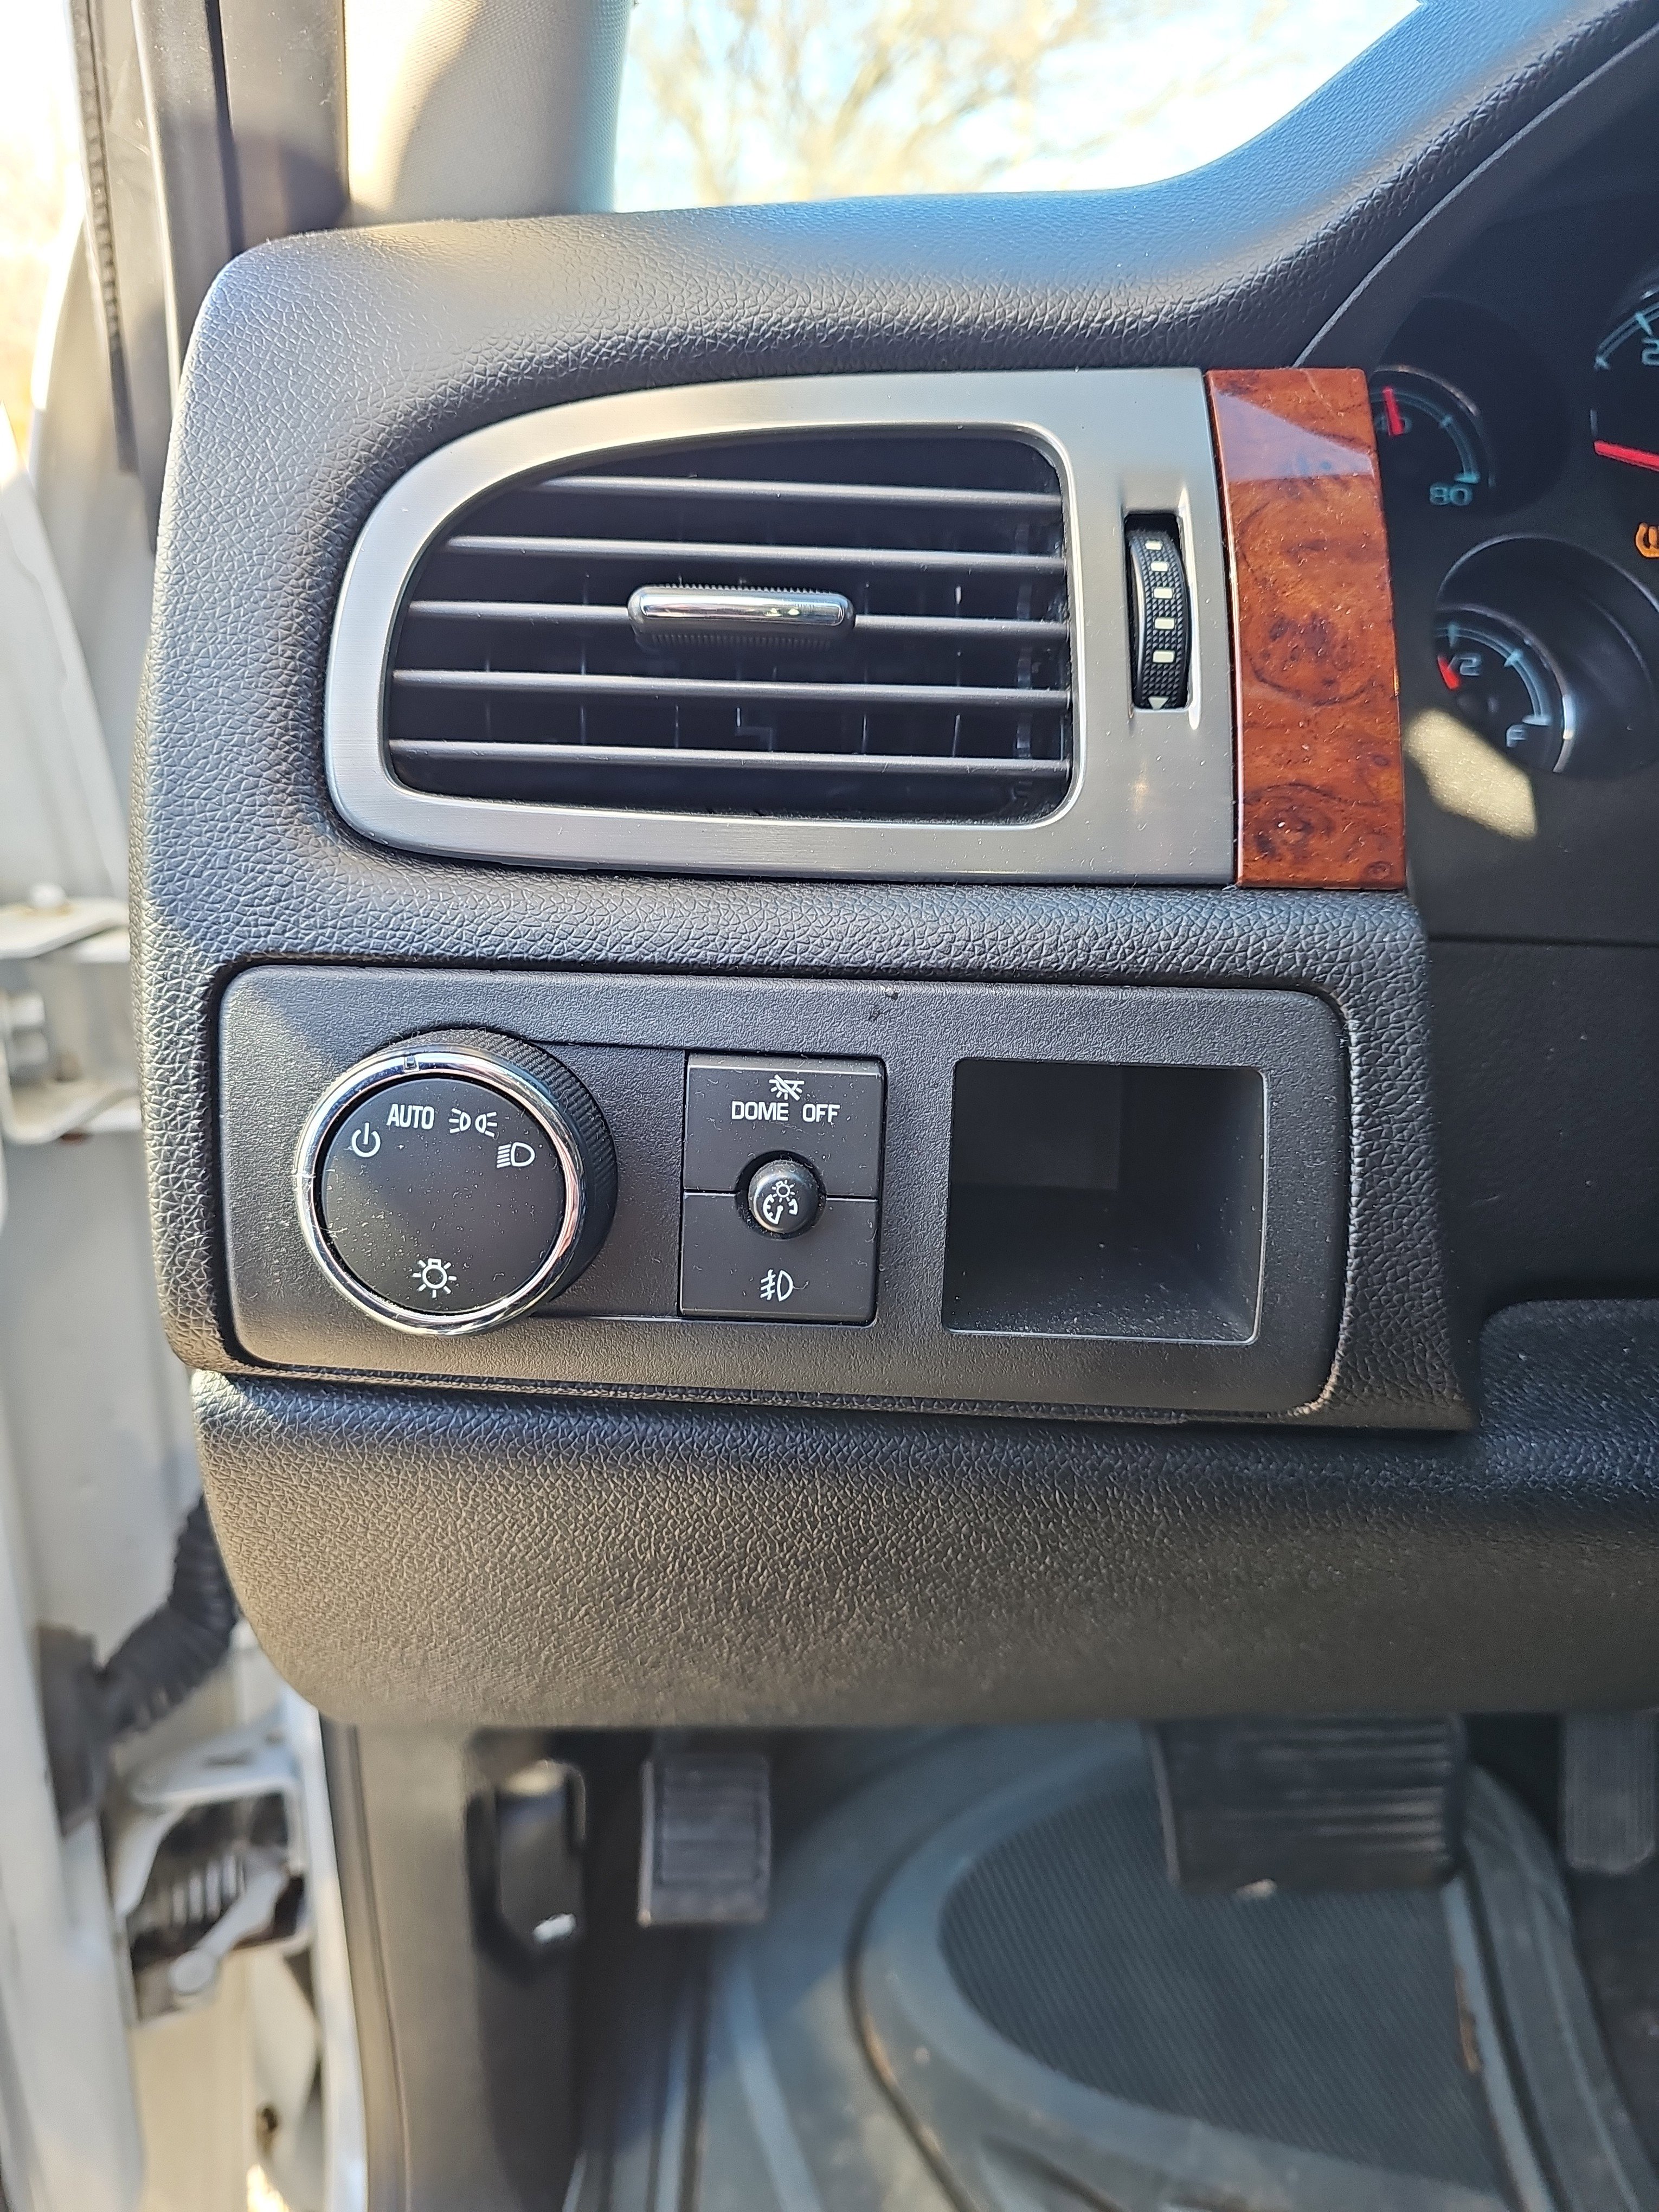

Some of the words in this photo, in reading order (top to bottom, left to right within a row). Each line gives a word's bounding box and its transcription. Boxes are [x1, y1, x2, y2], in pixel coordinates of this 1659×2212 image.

[1429, 483, 1473, 506] 80
[1506, 724, 1527, 748] F
[386, 1103, 435, 1130] AUTO
[731, 1101, 789, 1121] DOME
[802, 1104, 840, 1123] OFF
